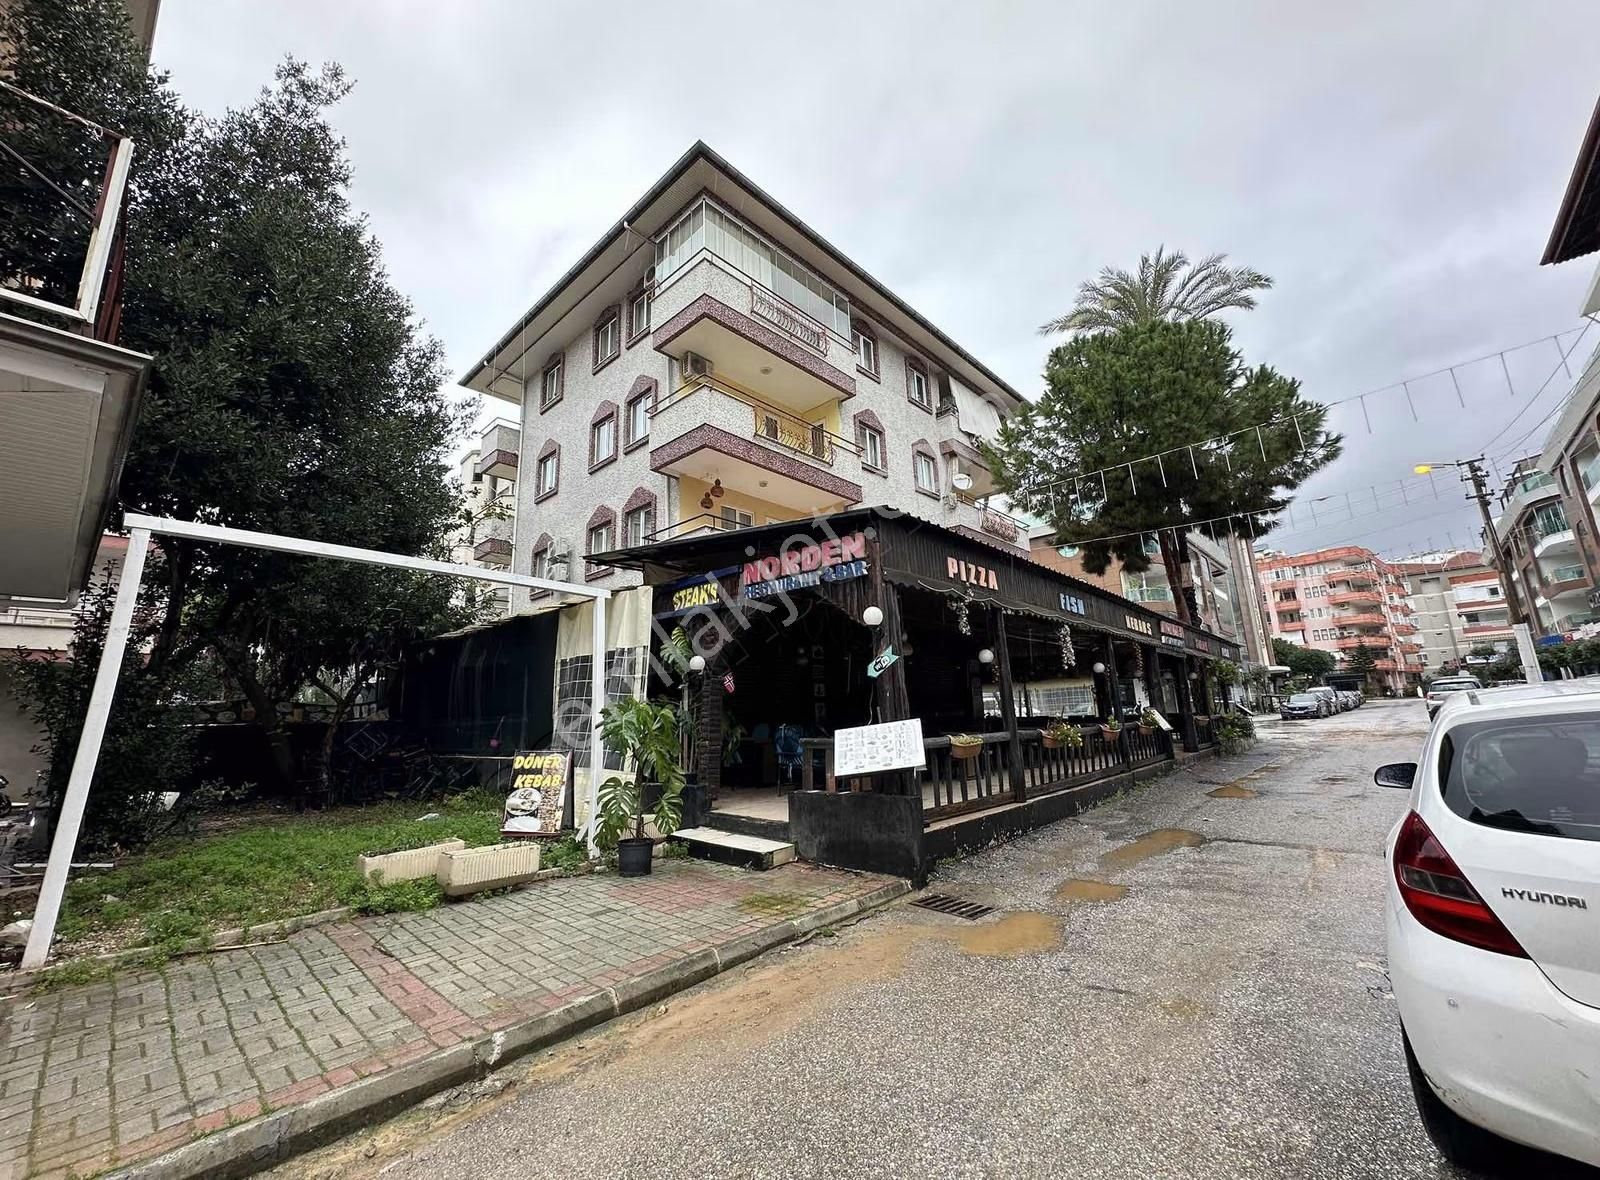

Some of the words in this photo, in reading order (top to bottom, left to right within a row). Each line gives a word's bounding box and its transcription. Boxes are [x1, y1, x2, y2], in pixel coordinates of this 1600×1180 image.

[743, 531, 867, 585] NORDEN
[947, 556, 999, 590] PIZZA
[744, 570, 822, 599] RESTAURANT
[1059, 593, 1085, 615] FISH
[513, 753, 561, 769] DÖNER
[513, 774, 561, 788] KEBAB
[1501, 887, 1588, 909] HYUNDAI
